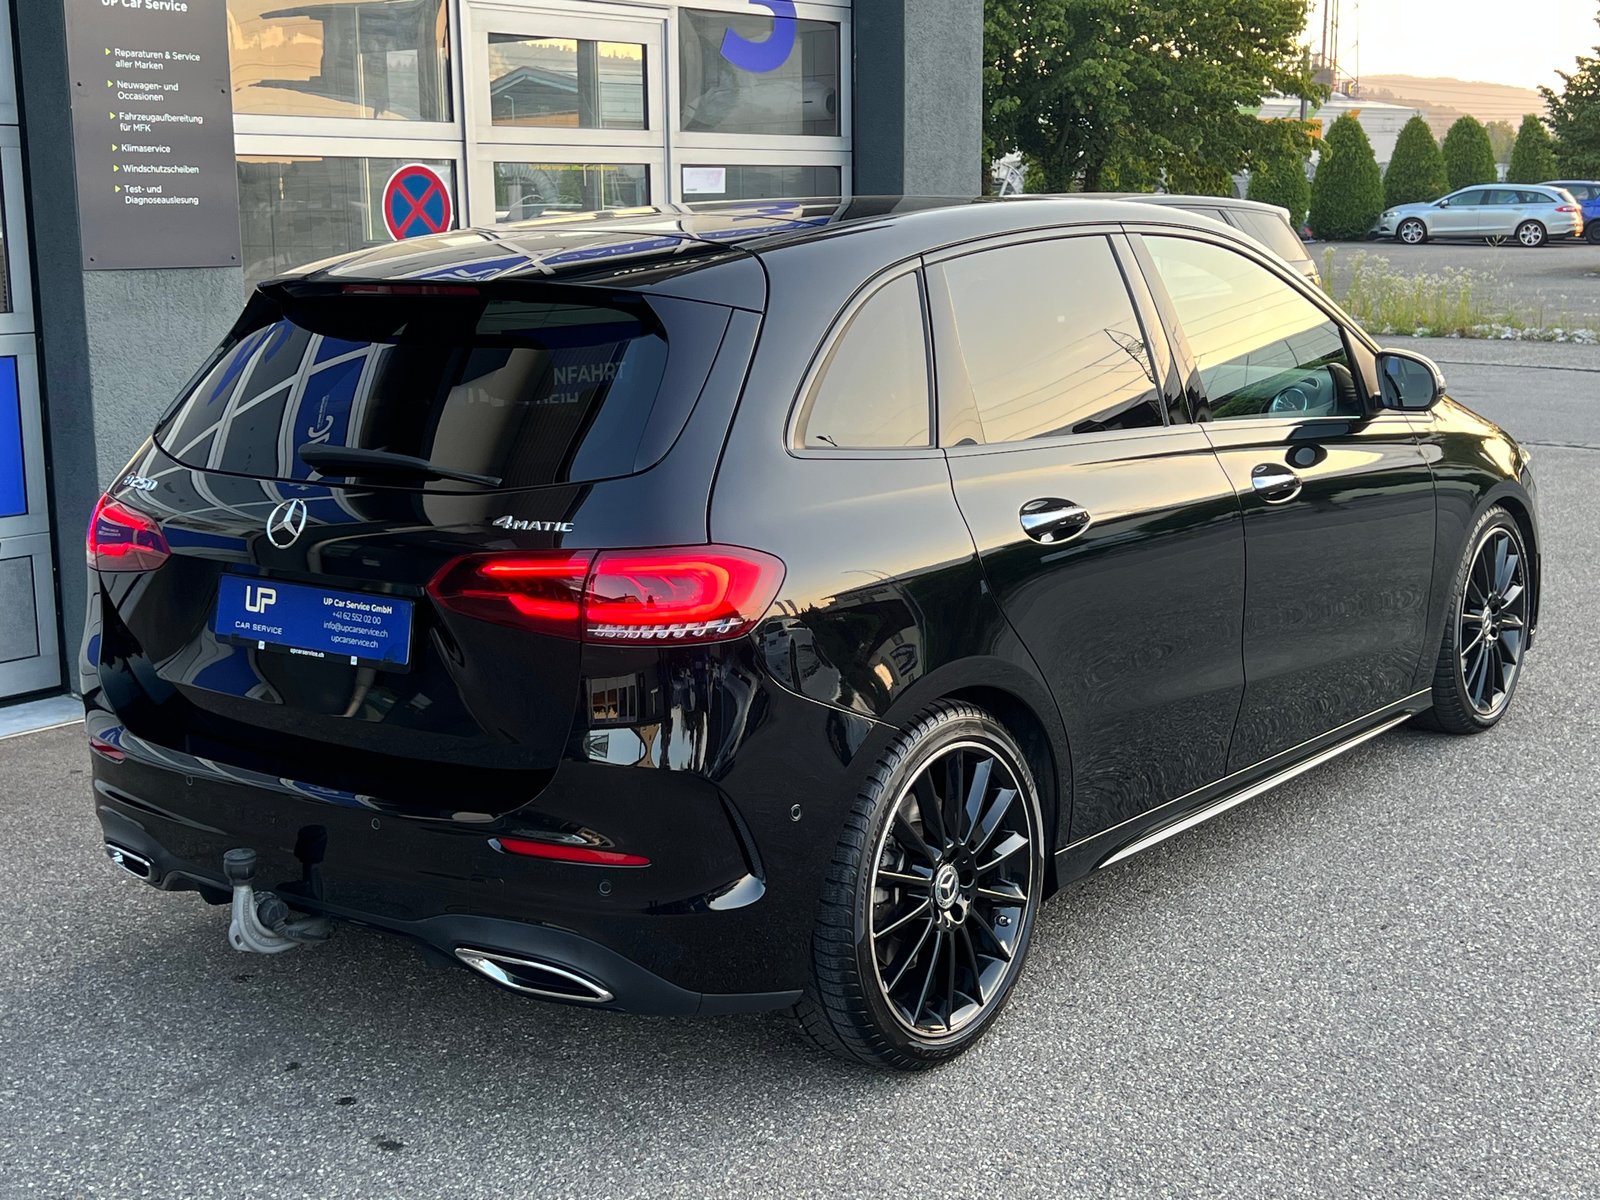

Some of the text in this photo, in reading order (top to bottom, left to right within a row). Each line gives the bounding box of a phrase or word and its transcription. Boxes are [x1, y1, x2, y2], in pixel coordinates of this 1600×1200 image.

[121, 0, 141, 8] Car
[145, 0, 188, 12] Service
[114, 48, 200, 61] Reparaturen & Service
[115, 60, 164, 70] aller Marken
[117, 80, 179, 91] Neuwagen- und
[117, 91, 164, 101] Occasionen
[119, 112, 203, 123] Fahrzeugaufbereitung
[120, 123, 151, 132] für MFK
[121, 144, 171, 153] Klimaservice
[122, 164, 200, 174] Windschutzscheiben
[124, 185, 162, 193] Test- und
[125, 195, 199, 205] Diagnoseauslesung
[492, 515, 575, 533] 4MATIC
[245, 585, 277, 614] UP
[323, 597, 393, 614] UP Car Service GmbH
[332, 610, 382, 625] +41 62 552 02 00
[235, 620, 283, 635] CAR SERVICE
[323, 621, 388, 637] info@upcarservice.ch
[330, 635, 379, 648] upcarservice.ch
